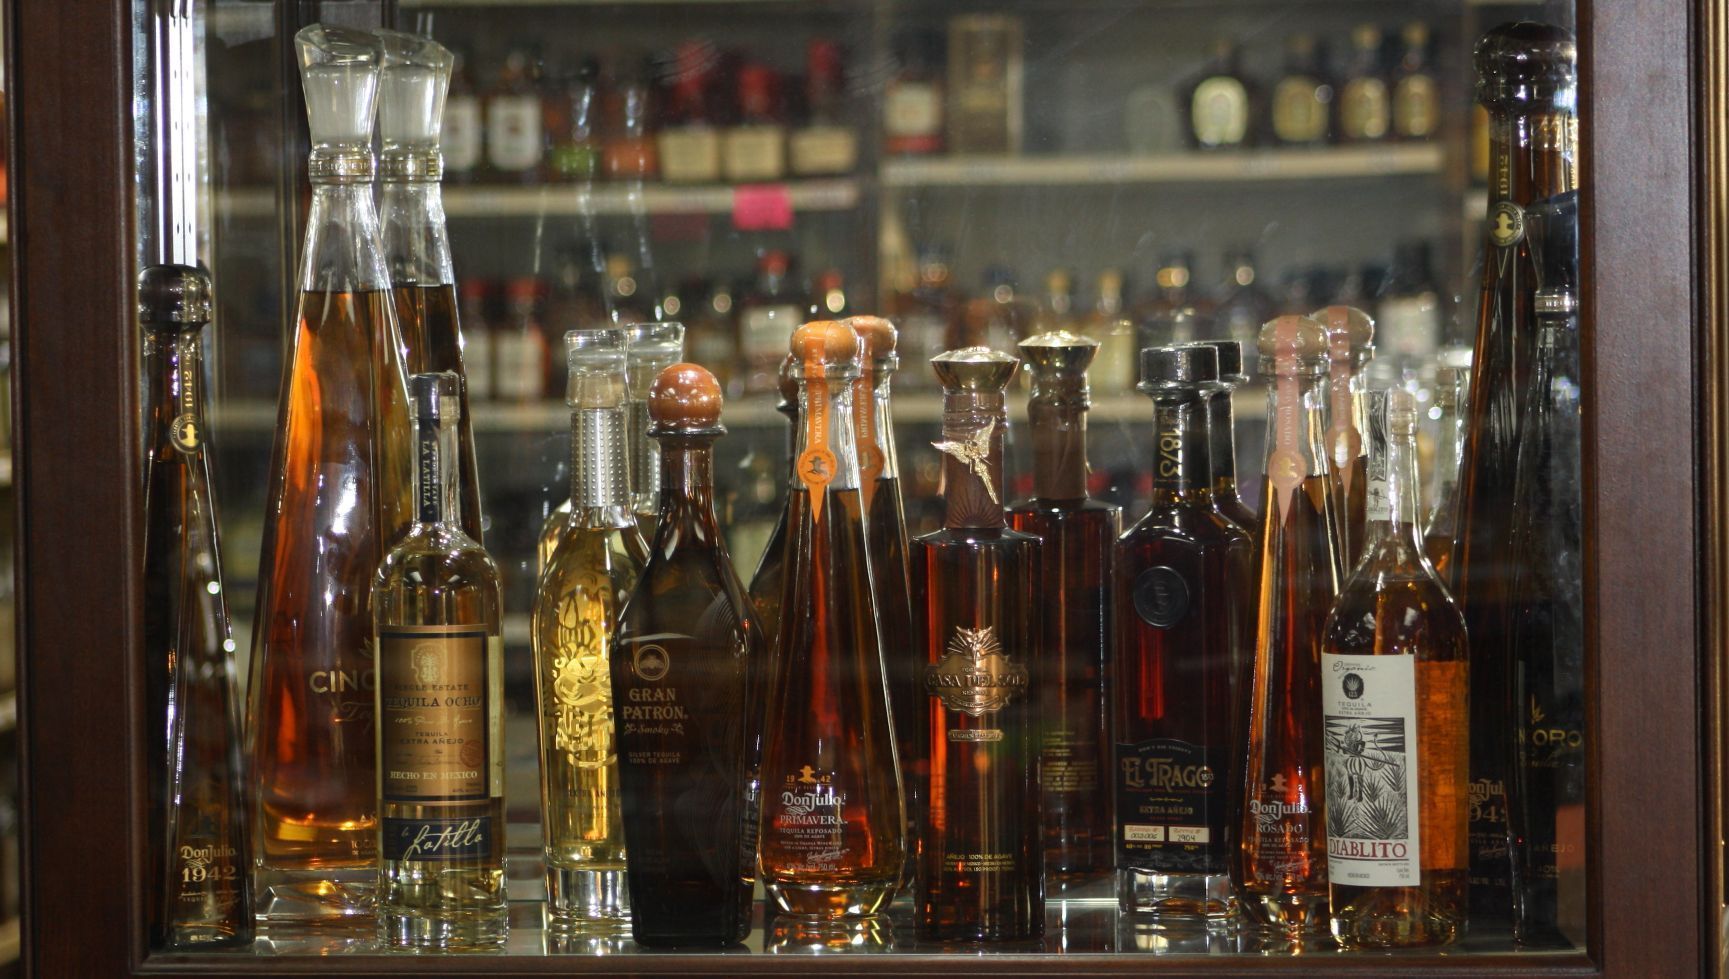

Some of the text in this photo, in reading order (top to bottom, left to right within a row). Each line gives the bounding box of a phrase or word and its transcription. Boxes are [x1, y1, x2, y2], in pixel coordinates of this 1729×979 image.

[1499, 155, 1509, 195] 1942
[184, 370, 193, 407] 1942
[1159, 428, 1183, 478] 1873
[422, 440, 431, 507] LA LATILLA
[927, 674, 962, 687] CASA
[628, 688, 676, 702] GRAN
[623, 703, 685, 720] PATRÓN
[432, 737, 465, 745] AÑEJO
[389, 771, 420, 780] HECHO
[423, 771, 438, 780] EN
[780, 815, 844, 825] PRIMAVERA
[1256, 823, 1303, 833] ROSADO
[1329, 839, 1407, 858] DIABLITO
[181, 866, 236, 882] 1942
